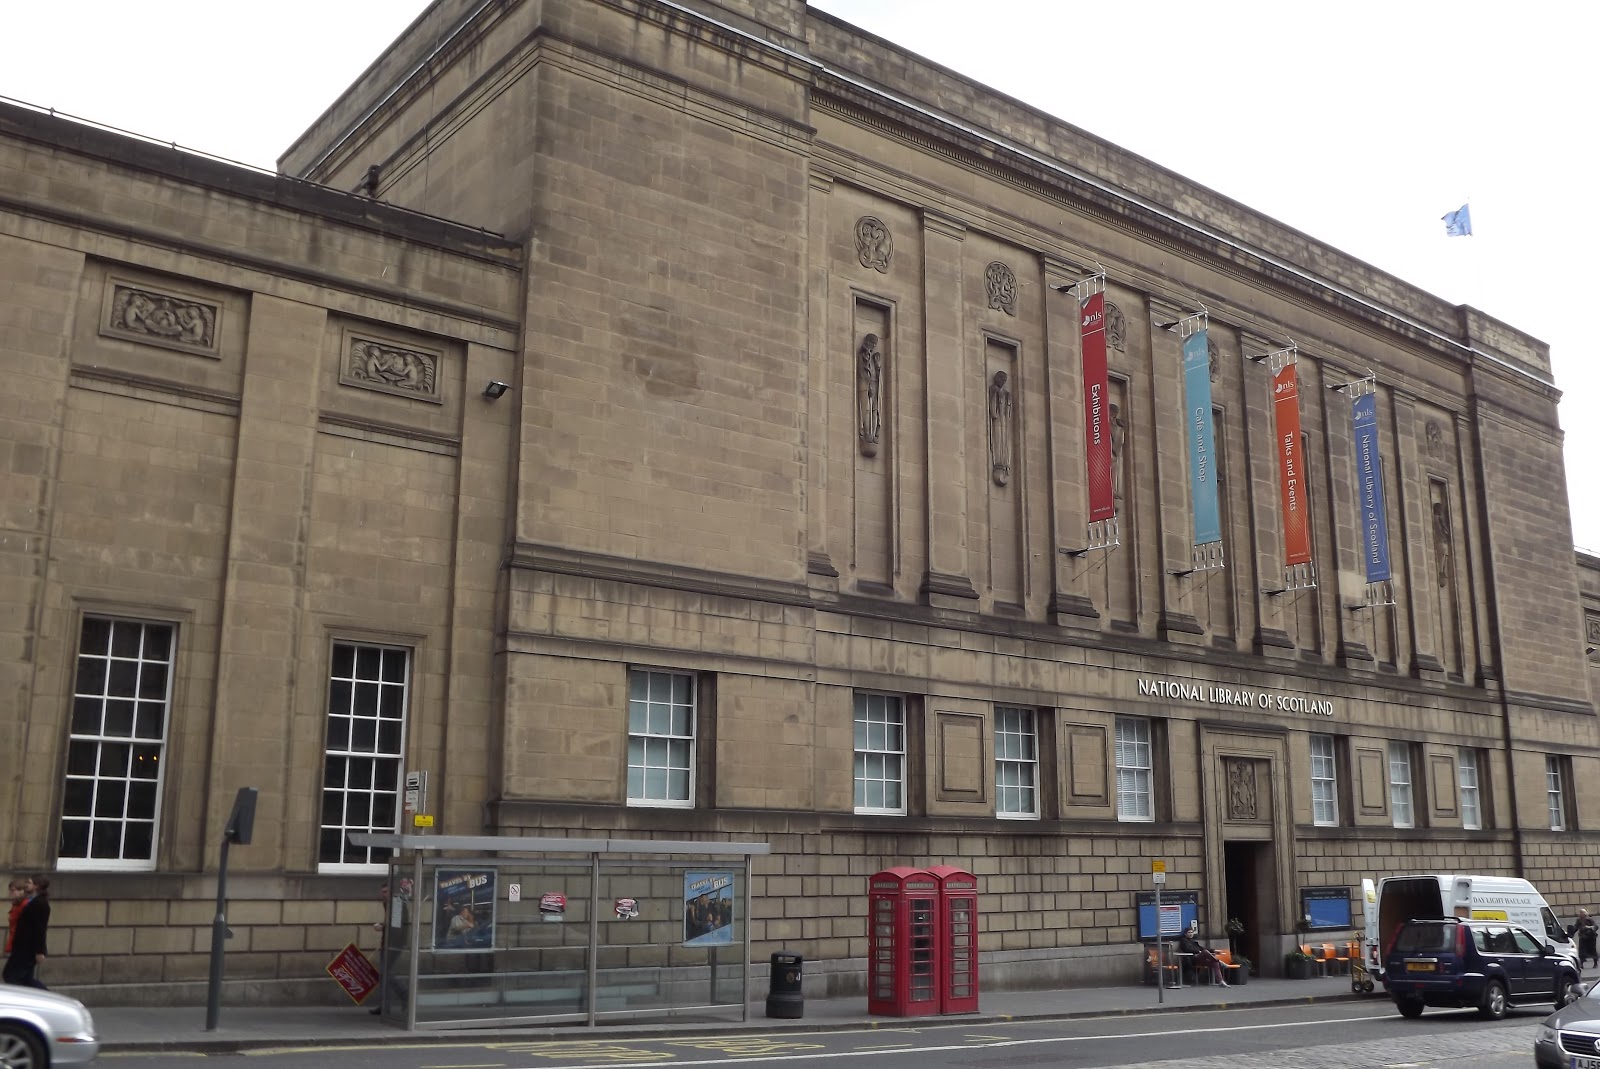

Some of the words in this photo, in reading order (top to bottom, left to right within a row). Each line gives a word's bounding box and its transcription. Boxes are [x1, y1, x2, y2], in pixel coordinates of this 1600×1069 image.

[1090, 311, 1102, 322] nls
[1282, 380, 1295, 390] nls
[1091, 383, 1102, 445] Exhibitions
[1361, 408, 1373, 417] nls
[1197, 434, 1206, 453] and
[1284, 431, 1294, 456] Talks
[1361, 434, 1373, 474] National
[1197, 455, 1207, 482] Shop
[1286, 458, 1296, 476] and
[1287, 478, 1297, 511] Events
[1365, 476, 1374, 509] Library
[1368, 512, 1377, 521] of
[1369, 523, 1381, 564] Scotland
[1137, 678, 1206, 702] NATIONAL
[1209, 686, 1255, 707] LIBRARY
[1258, 693, 1273, 709] OF
[1276, 695, 1333, 716] SCOTLAND
[469, 875, 488, 889] BUS
[713, 877, 728, 889] BUS
